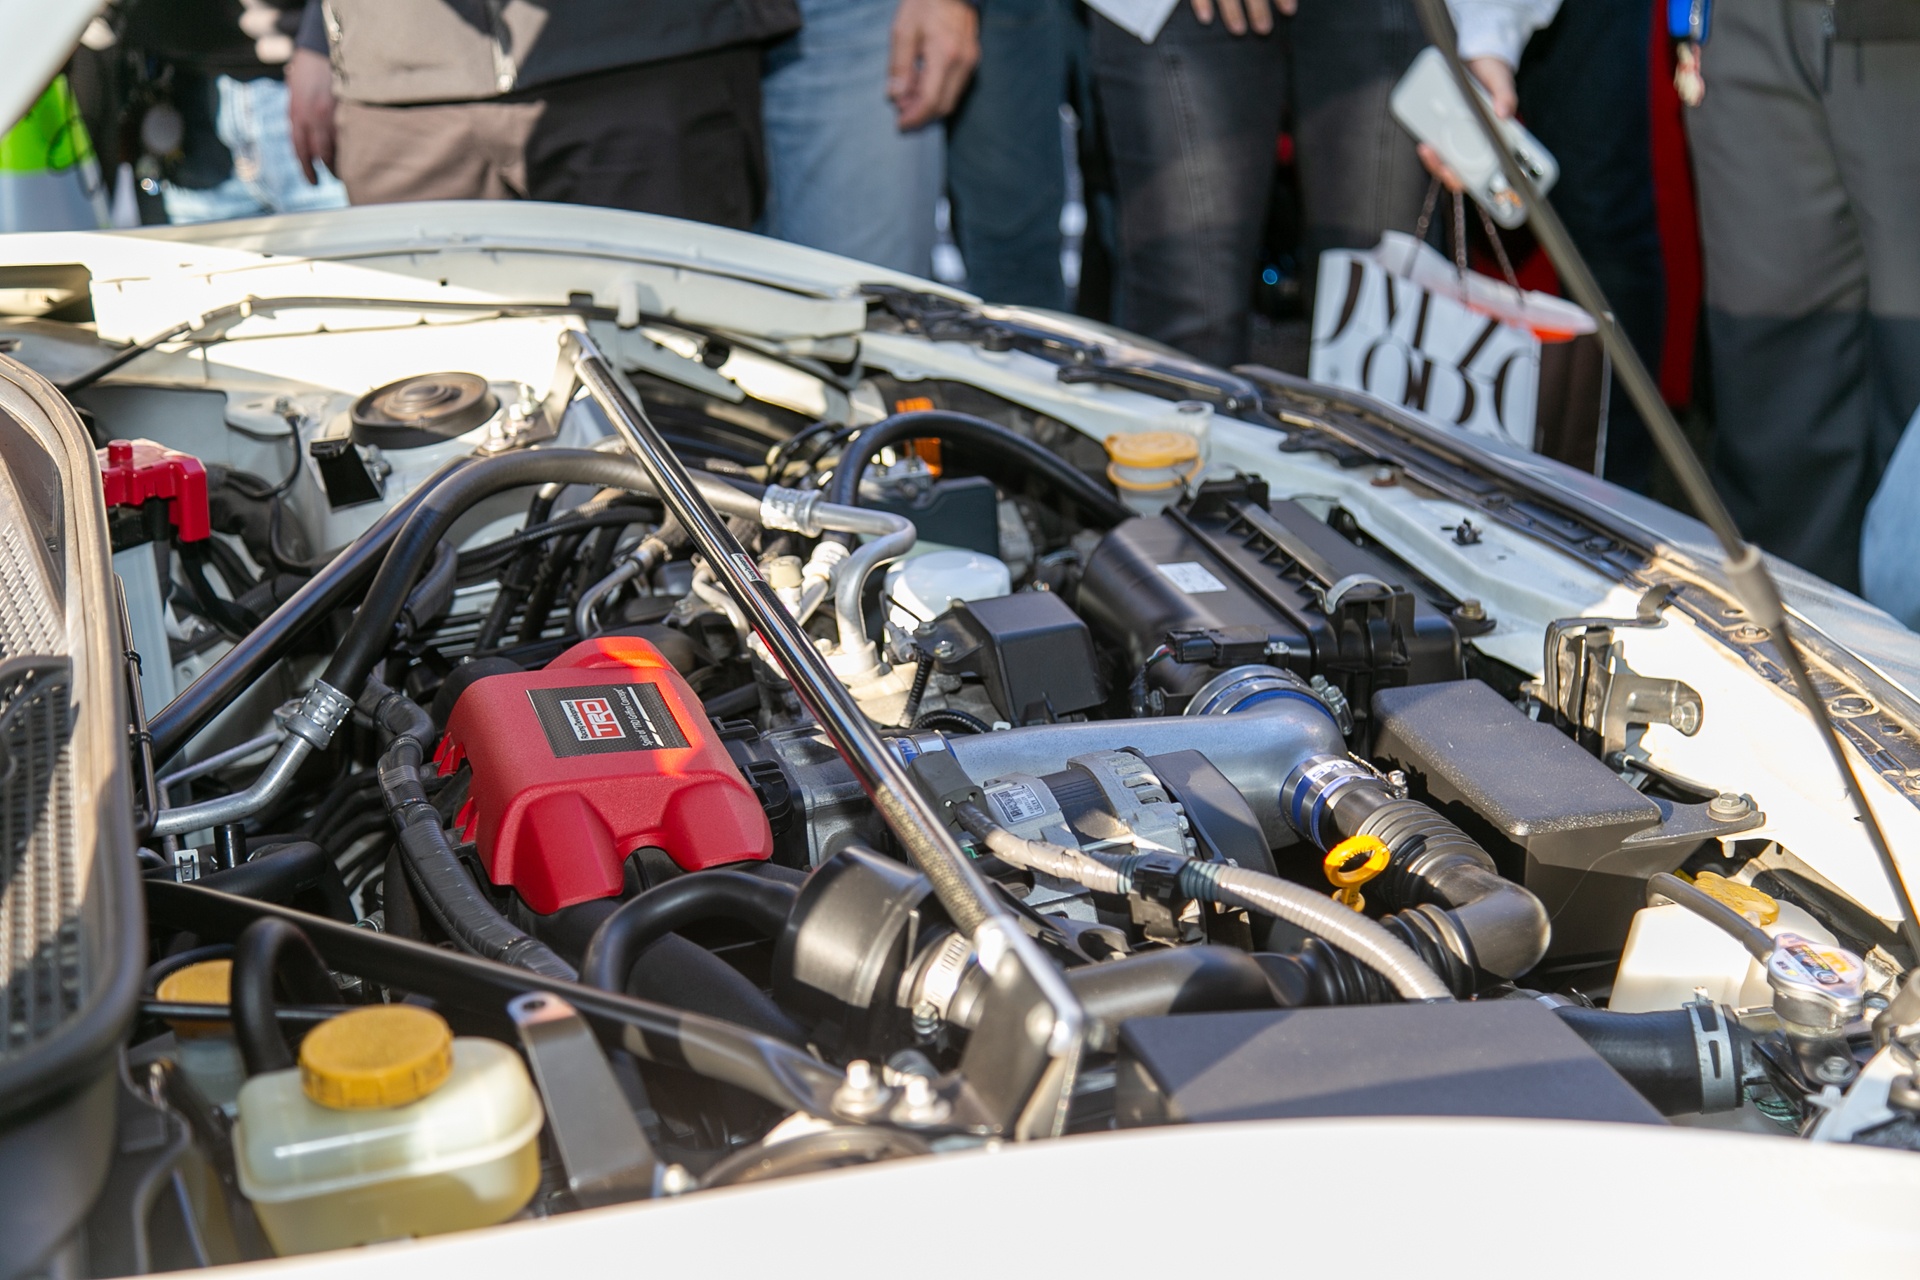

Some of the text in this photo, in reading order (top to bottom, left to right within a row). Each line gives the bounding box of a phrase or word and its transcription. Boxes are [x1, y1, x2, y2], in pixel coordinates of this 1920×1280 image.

[564, 701, 589, 740] Racing Development
[582, 701, 614, 737] TRD
[640, 734, 654, 747] Spirit
